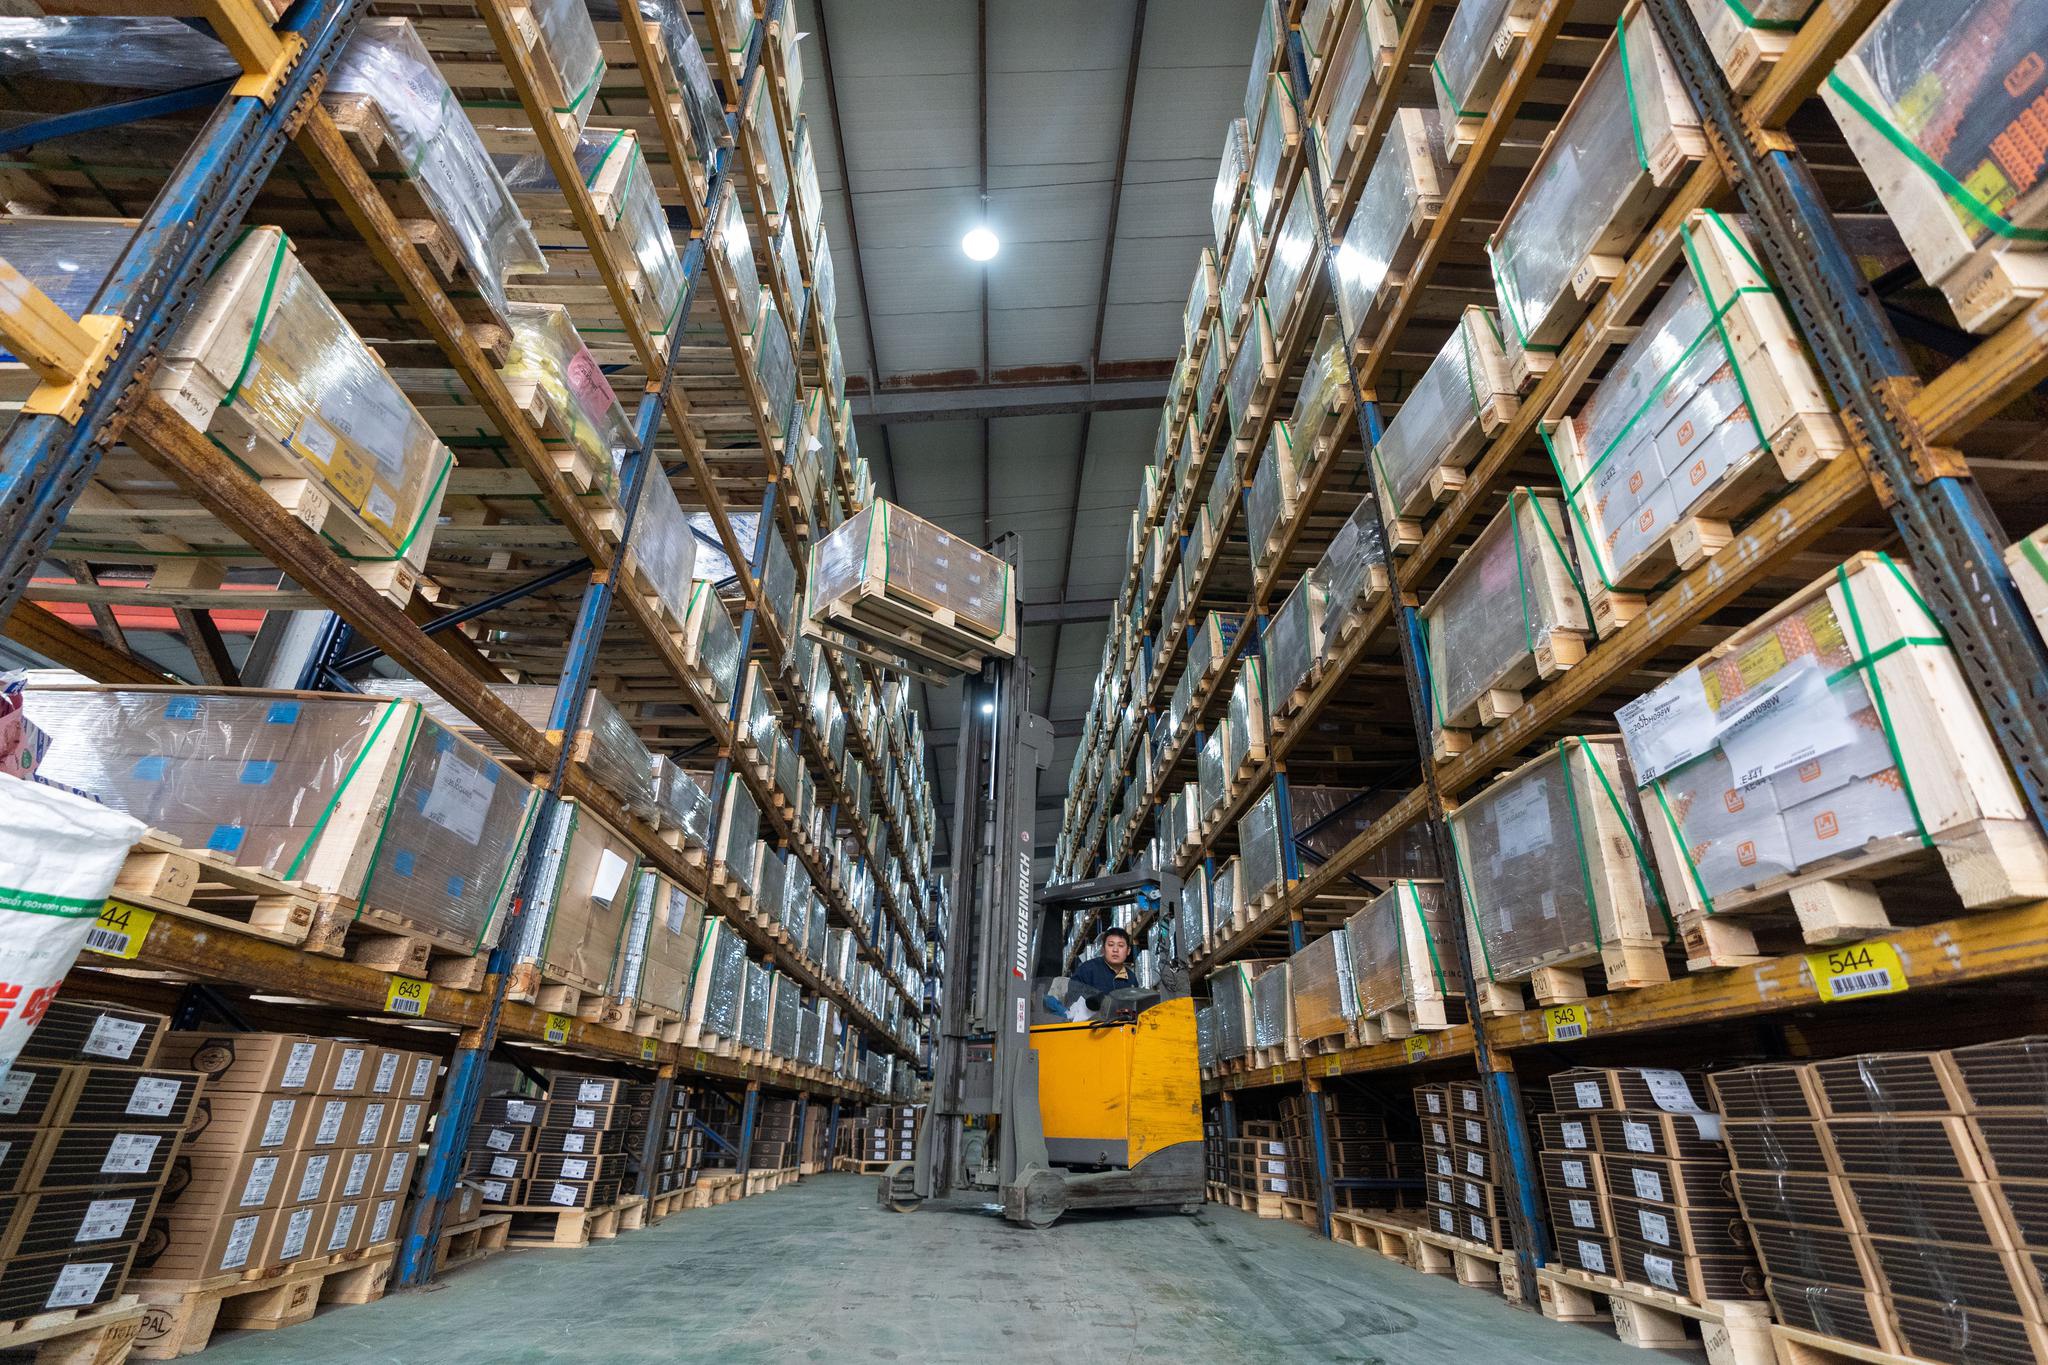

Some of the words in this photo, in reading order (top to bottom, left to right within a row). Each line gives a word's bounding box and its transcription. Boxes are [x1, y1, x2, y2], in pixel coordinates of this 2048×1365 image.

[99, 906, 132, 931] 44
[1013, 852, 1031, 981] JUNGHEINRICH
[1828, 948, 1874, 974] 544
[398, 981, 421, 998] 643
[552, 1018, 566, 1031] 642
[1554, 1008, 1576, 1025] 543
[1411, 1038, 1423, 1051] 542
[138, 1315, 166, 1333] PAL
